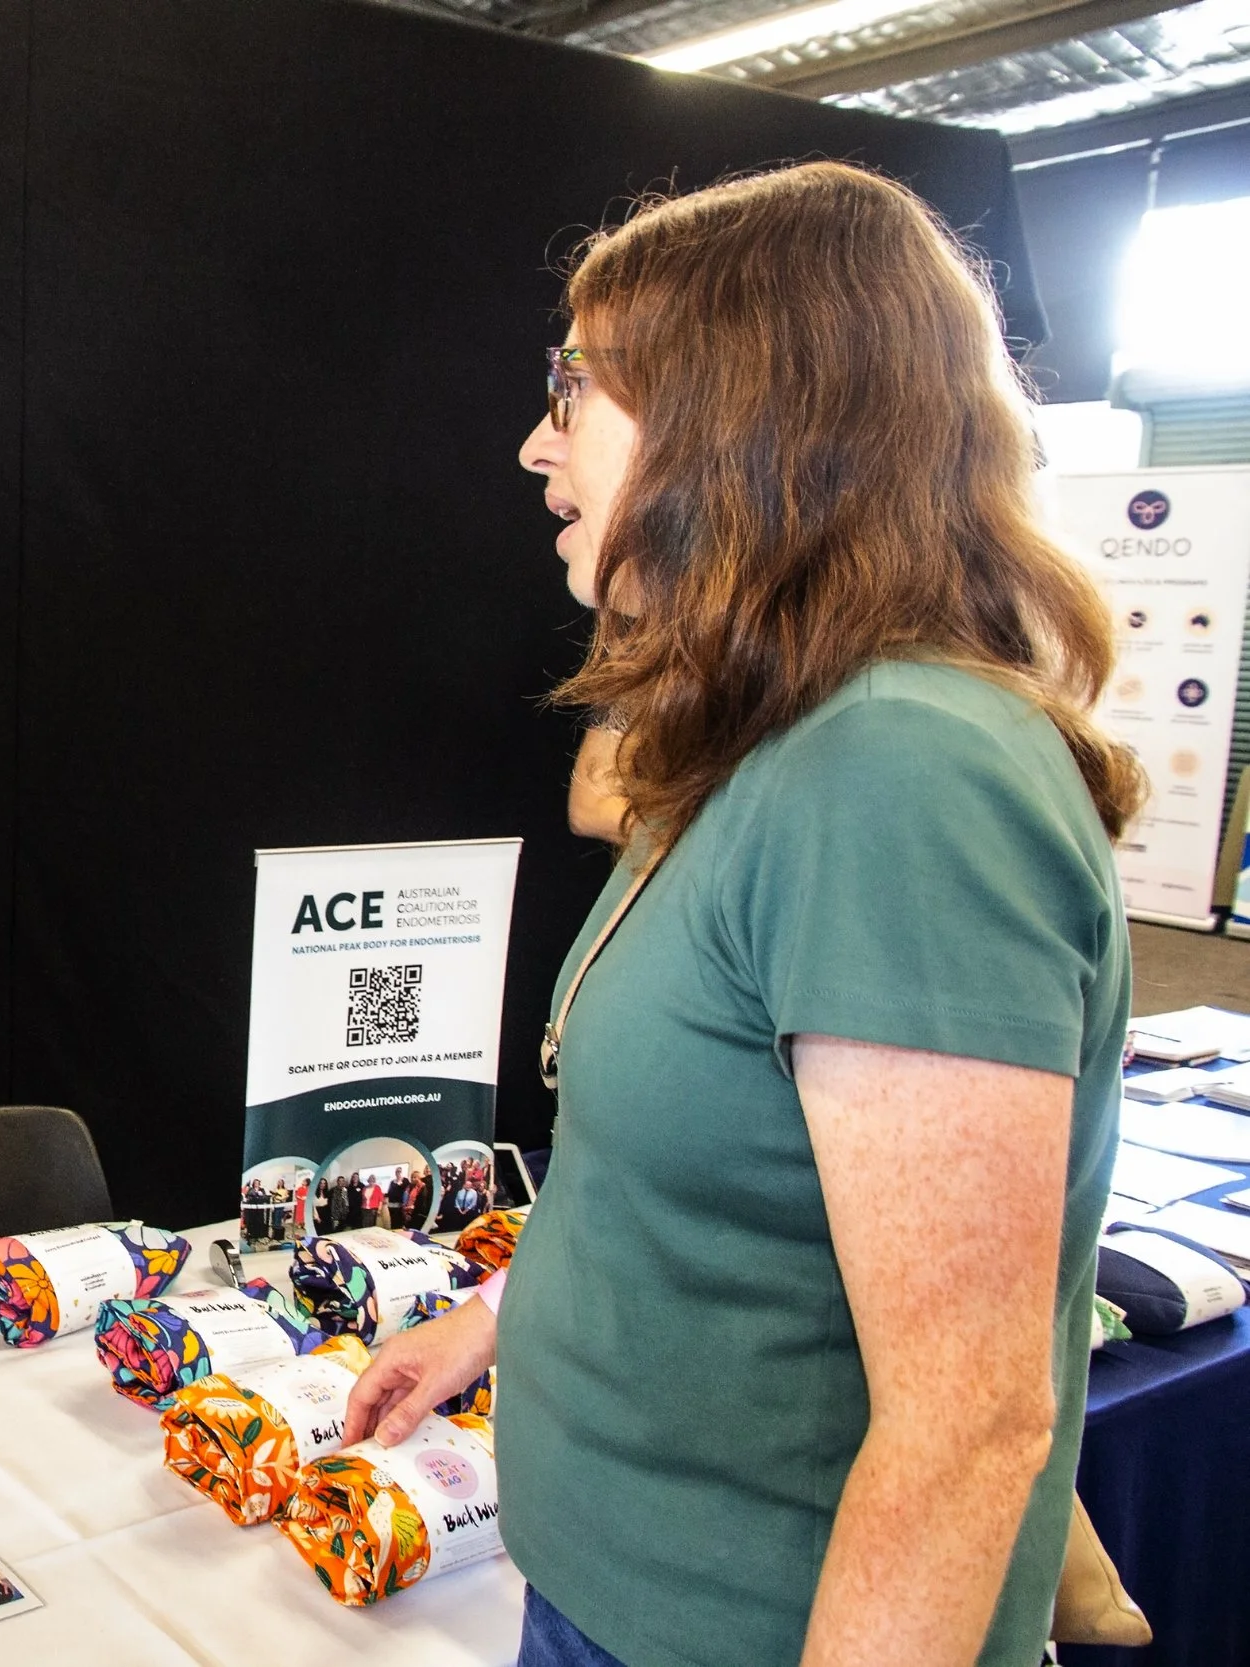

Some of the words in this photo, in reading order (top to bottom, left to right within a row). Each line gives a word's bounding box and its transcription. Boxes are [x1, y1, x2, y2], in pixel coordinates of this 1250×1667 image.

[1100, 537, 1192, 559] QENDO
[397, 887, 460, 899] AUSTRALIAN
[291, 890, 384, 934] ACE
[397, 902, 454, 914] COALITION
[456, 900, 478, 911] FOR
[396, 914, 481, 928] ENDOMETRIOSIS
[292, 944, 337, 955] NATIONAL
[339, 941, 361, 951] PEAK
[363, 939, 387, 949] BODY
[390, 938, 407, 948] FOR
[409, 935, 481, 947] ENDOMETRIOSIS
[288, 1064, 315, 1074] SCAN
[317, 1062, 334, 1072] THE
[336, 1061, 350, 1070] QR
[352, 1058, 378, 1068] CODE
[380, 1056, 393, 1066] TO
[395, 1055, 418, 1065] JOIN
[420, 1054, 433, 1063] AS
[434, 1054, 441, 1062] A
[443, 1050, 483, 1061] MEMBER
[324, 1093, 441, 1112] ENDOCOALITION.ORG.AU
[378, 1257, 403, 1270] Back
[401, 1256, 428, 1270] Wrap
[189, 1303, 217, 1313] Back
[217, 1302, 247, 1313] Wrap
[311, 1419, 343, 1444] Back
[443, 1504, 479, 1532] Back
[474, 1502, 498, 1522] Wra
